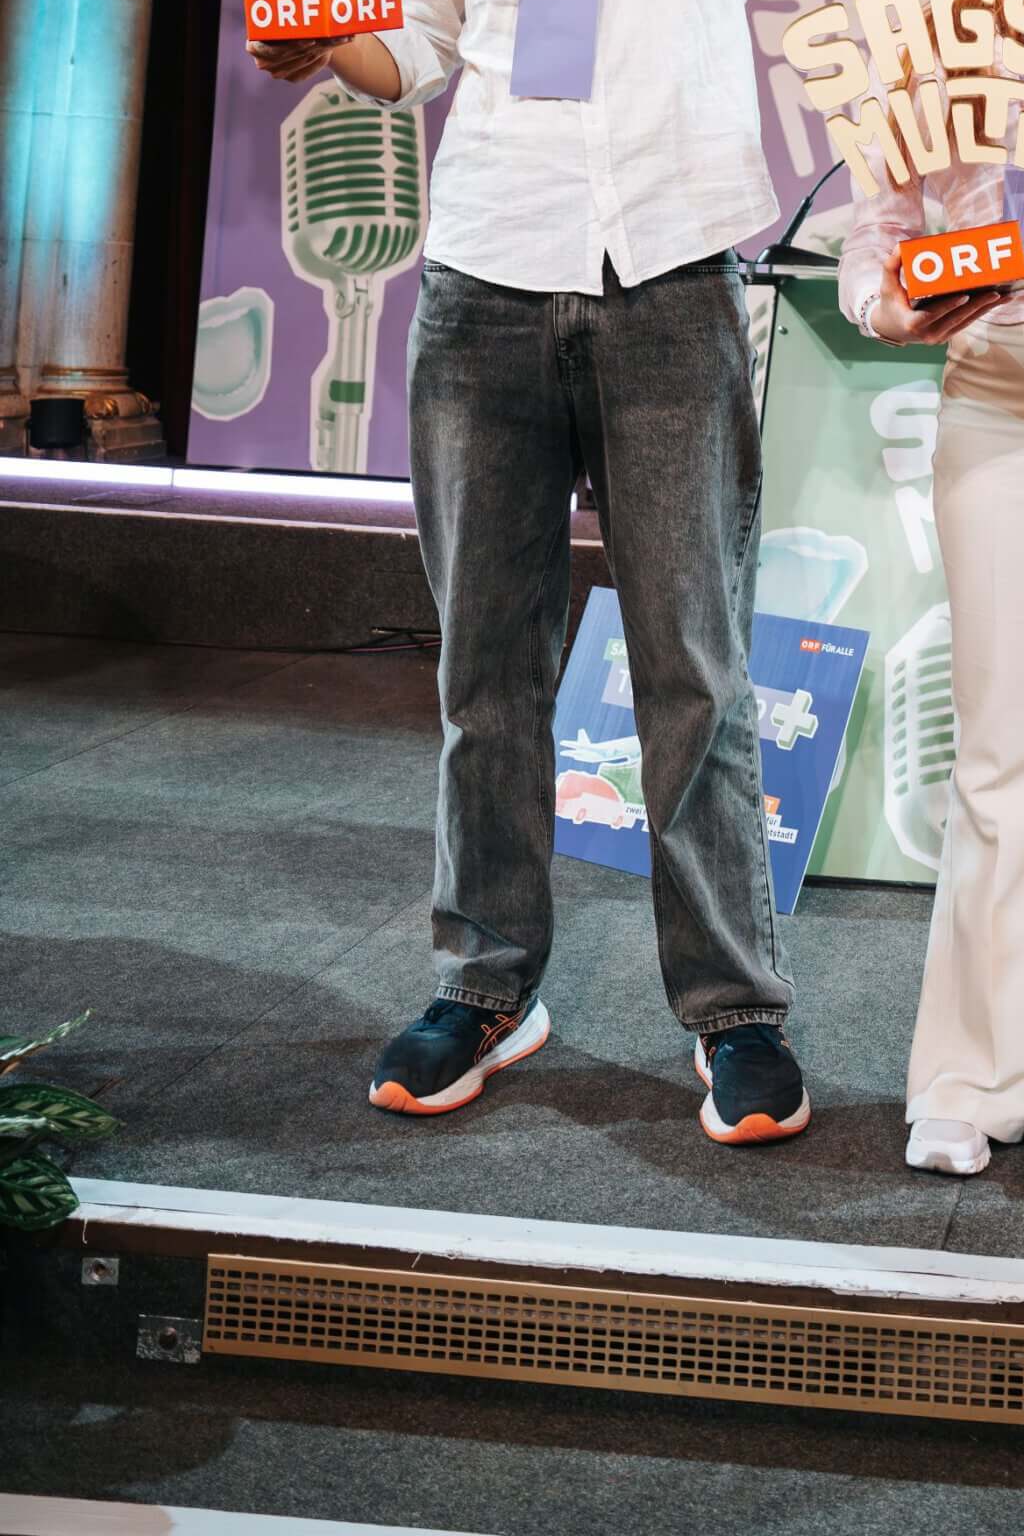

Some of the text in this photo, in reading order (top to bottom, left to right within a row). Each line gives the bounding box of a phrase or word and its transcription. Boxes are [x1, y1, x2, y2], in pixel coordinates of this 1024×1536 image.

[911, 236, 1014, 282] ORF
[801, 640, 855, 656] ORF FÜR ALLE
